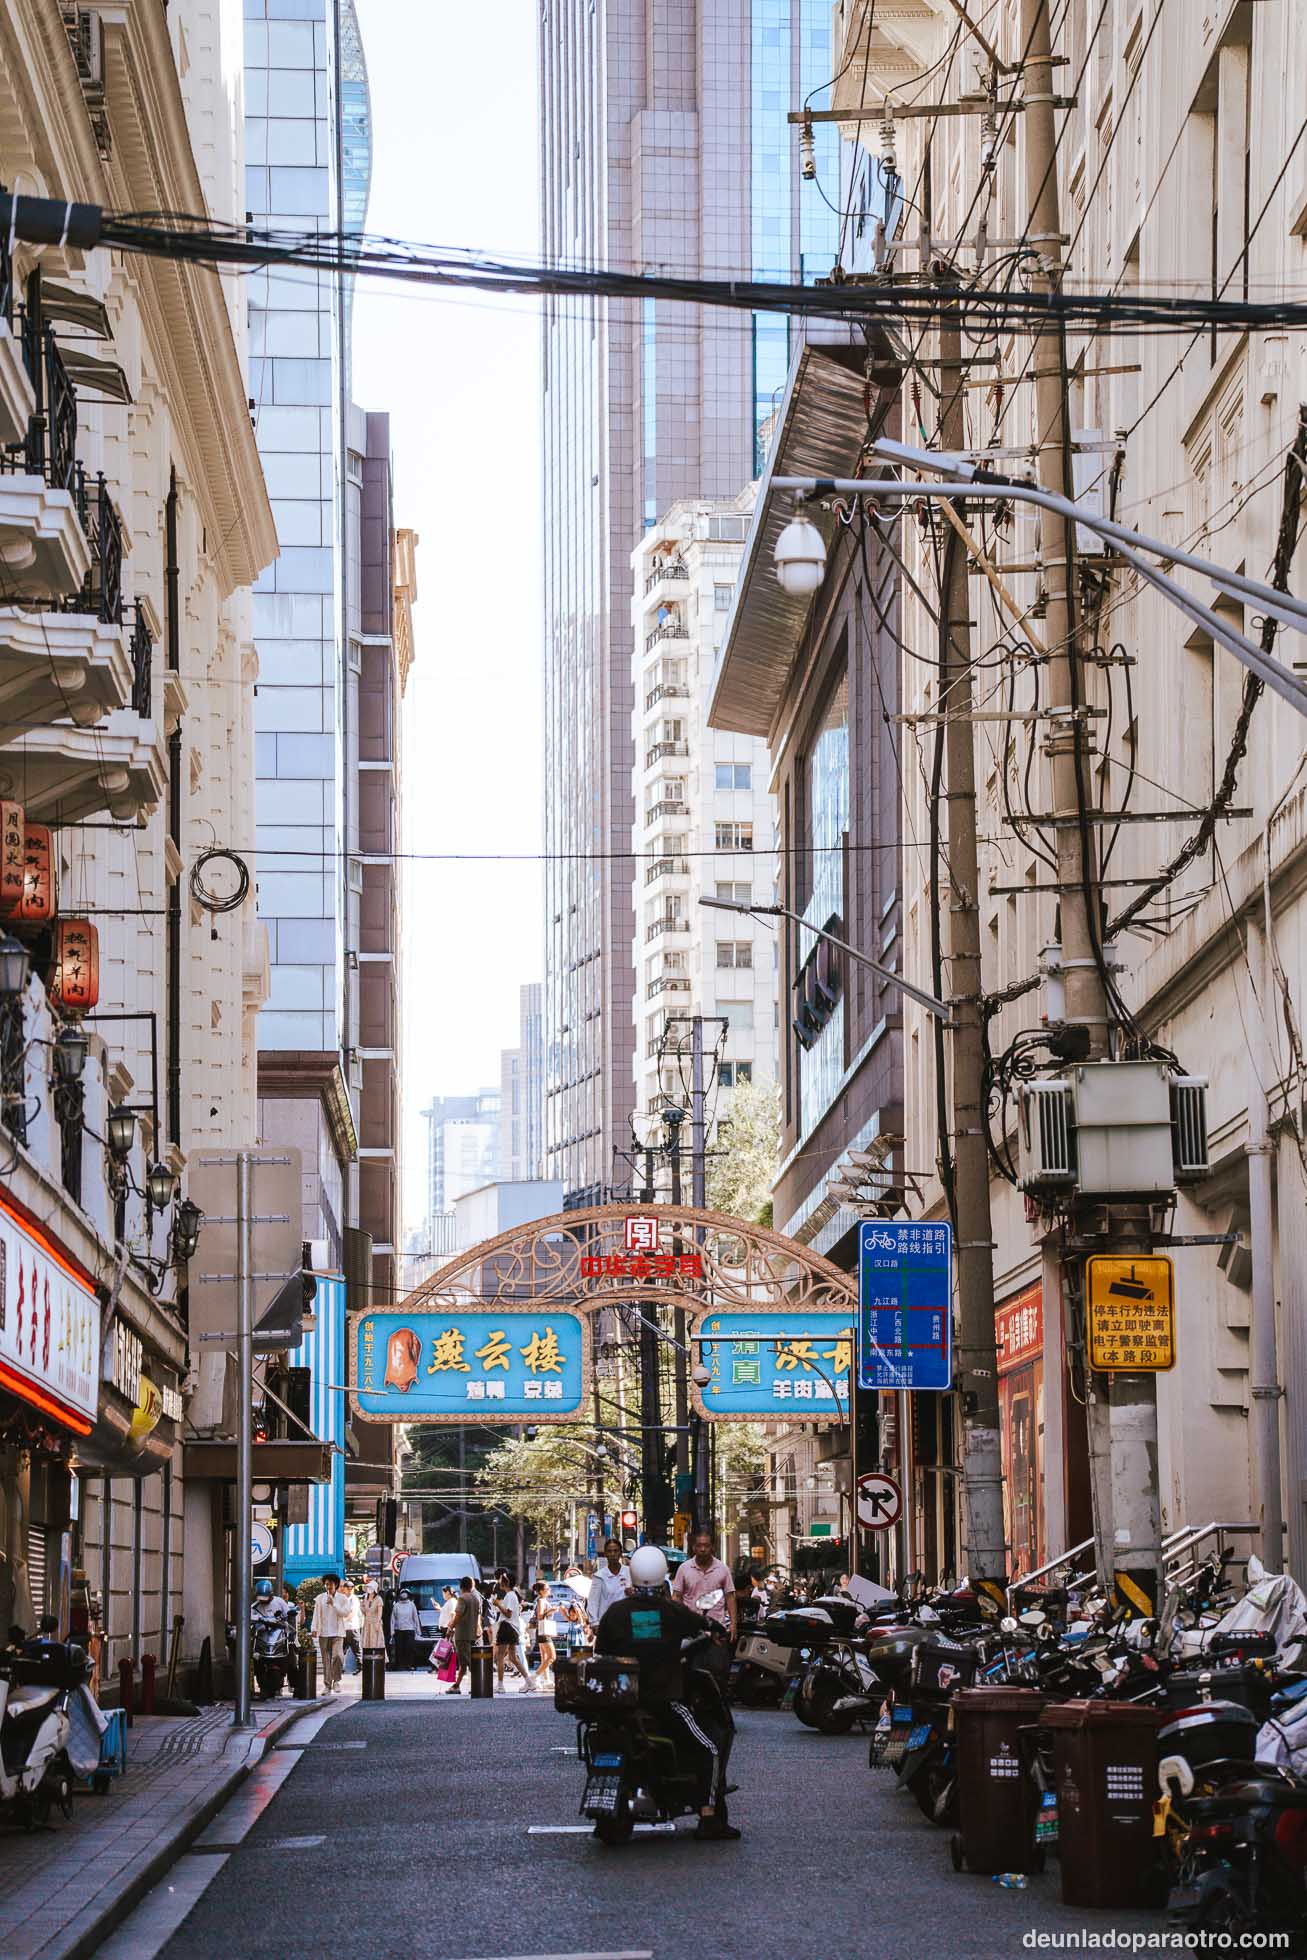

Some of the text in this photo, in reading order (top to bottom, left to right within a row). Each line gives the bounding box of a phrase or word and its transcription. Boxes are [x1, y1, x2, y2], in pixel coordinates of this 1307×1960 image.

[897, 1229, 945, 1241] 禁非道路
[897, 1242, 945, 1254] 路线指引
[874, 1260, 898, 1268] 汉口路
[874, 1297, 898, 1306] 九江路
[1094, 1304, 1169, 1317] 停车行为违法
[1097, 1320, 1165, 1332] 请立即驶离
[1094, 1335, 1169, 1347] 电子警察监管
[427, 1327, 567, 1374] 燕云楼
[711, 1320, 721, 1395] 创于一八九一年
